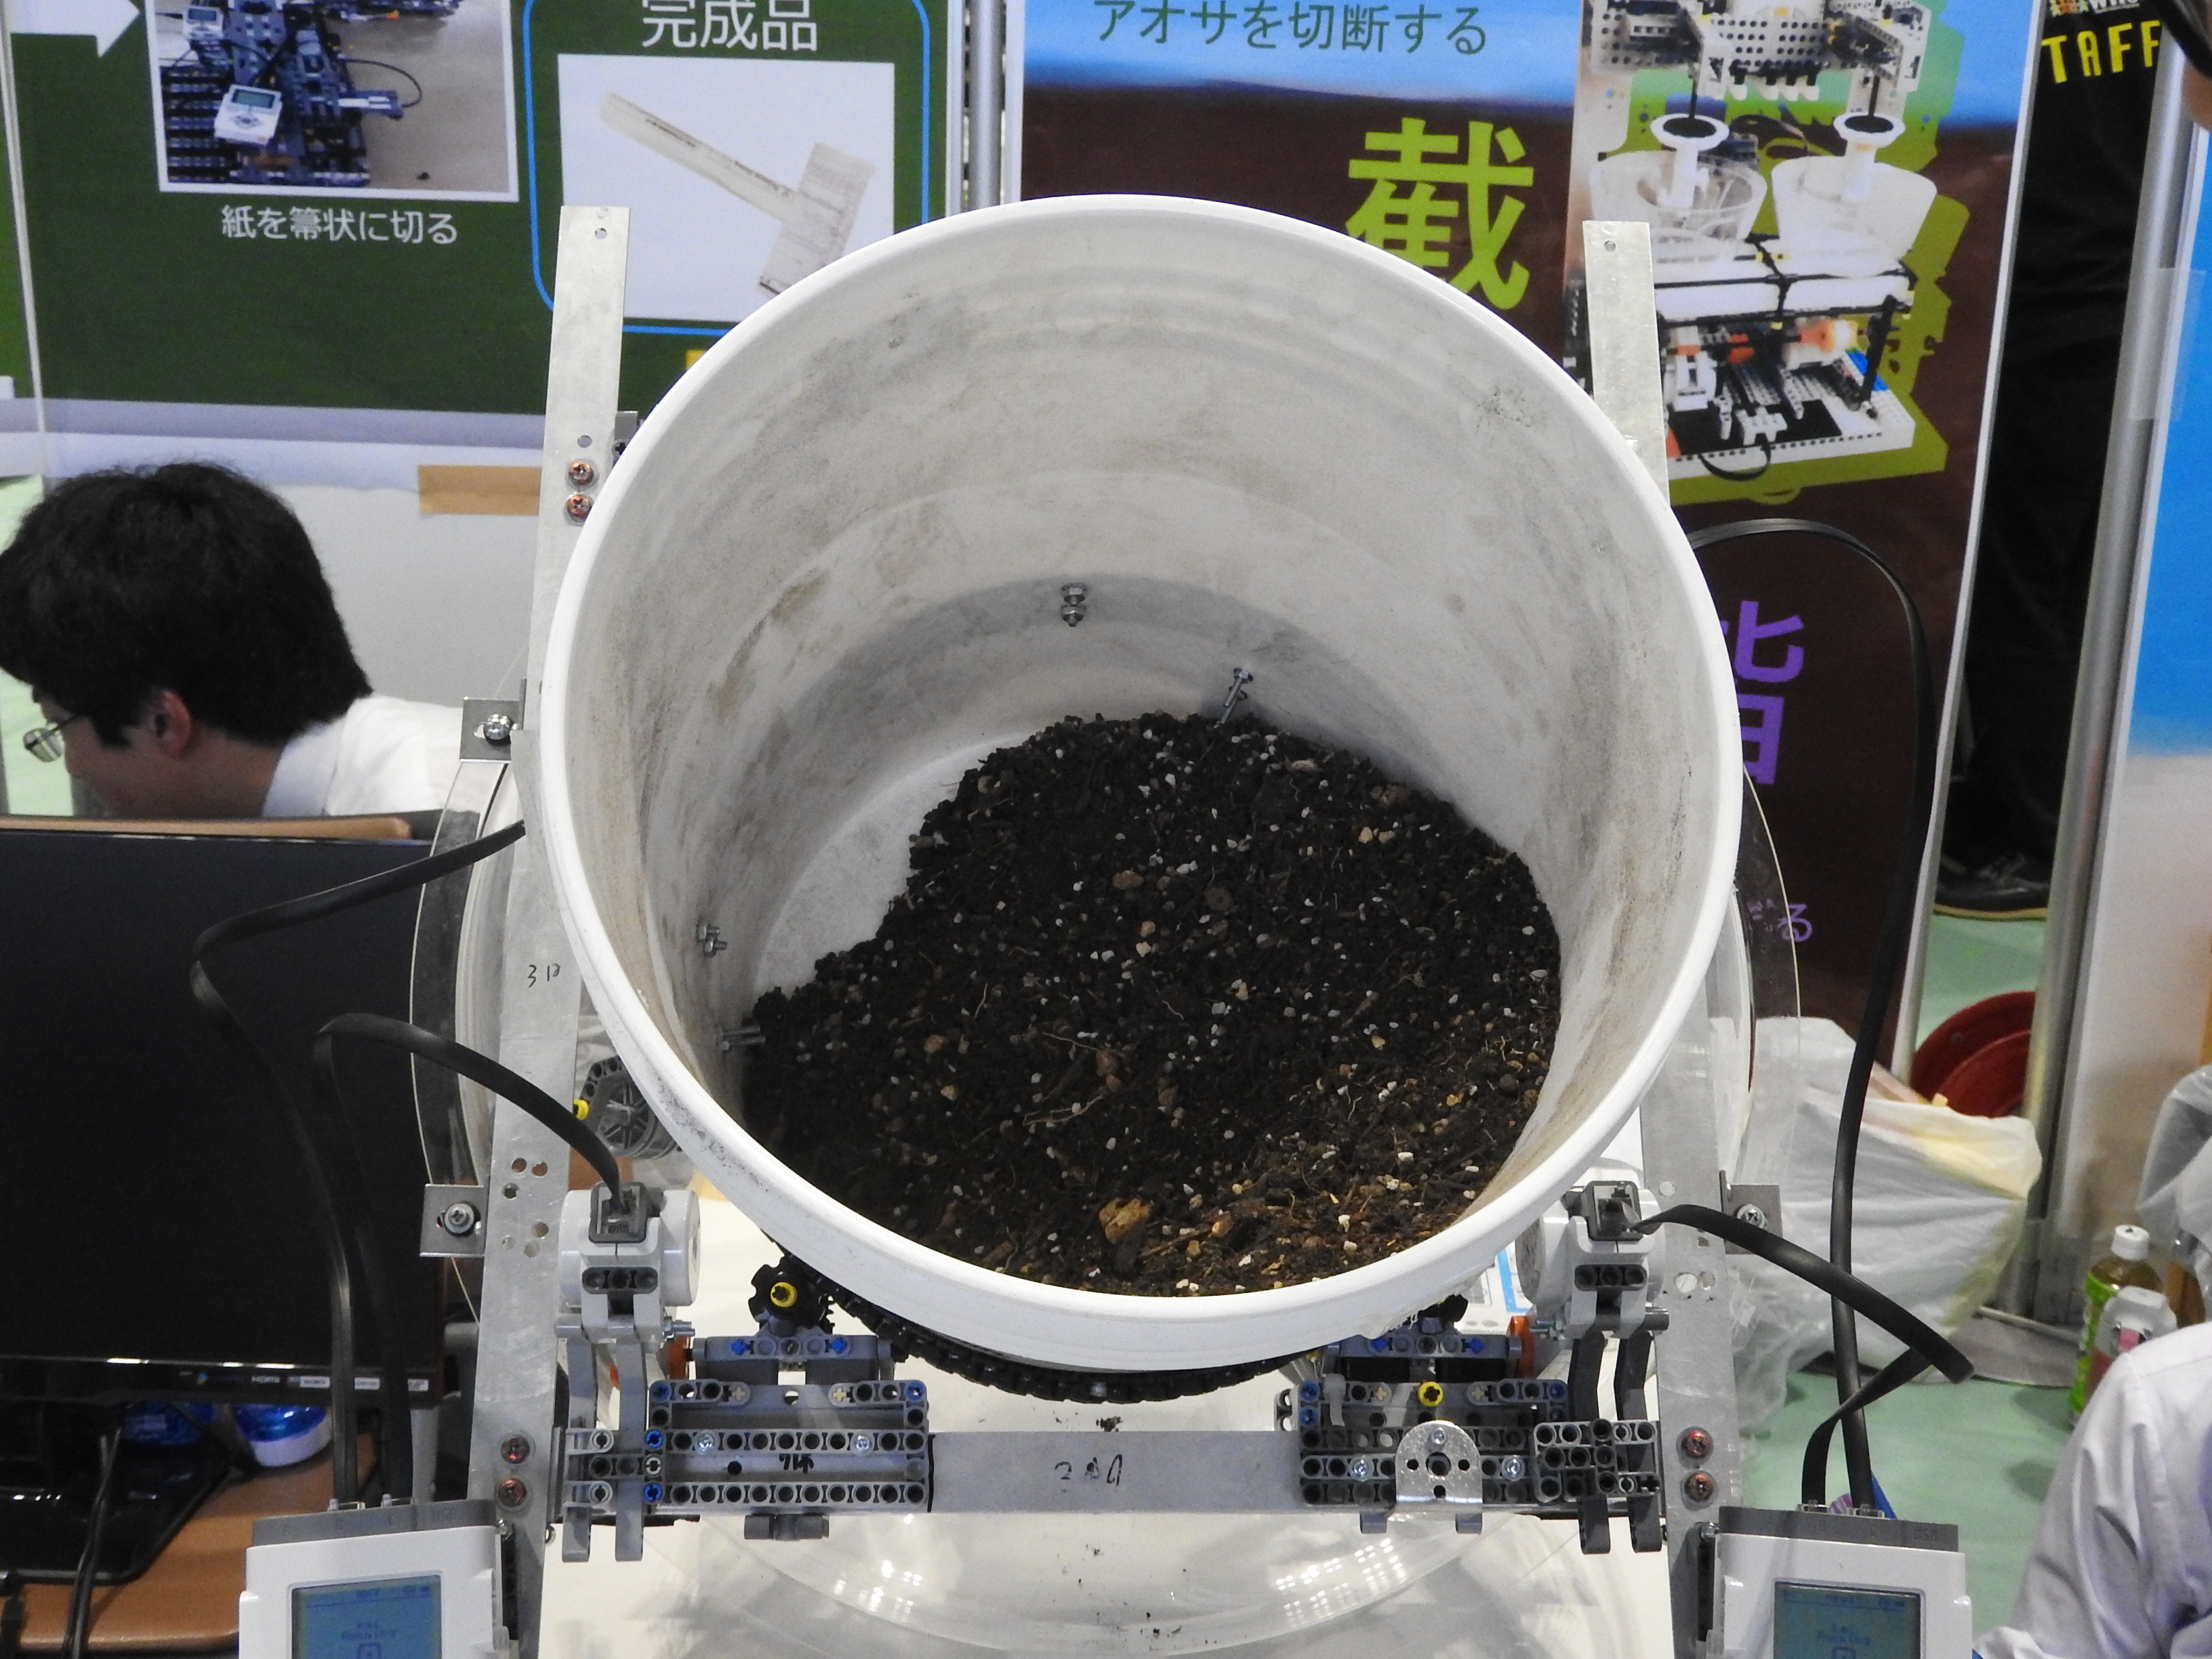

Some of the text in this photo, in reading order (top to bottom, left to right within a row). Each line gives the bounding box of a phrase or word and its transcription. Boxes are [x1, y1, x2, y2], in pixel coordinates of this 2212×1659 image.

[642, 0, 817, 52] 完成品
[1094, 0, 1487, 55] アオサを切断する
